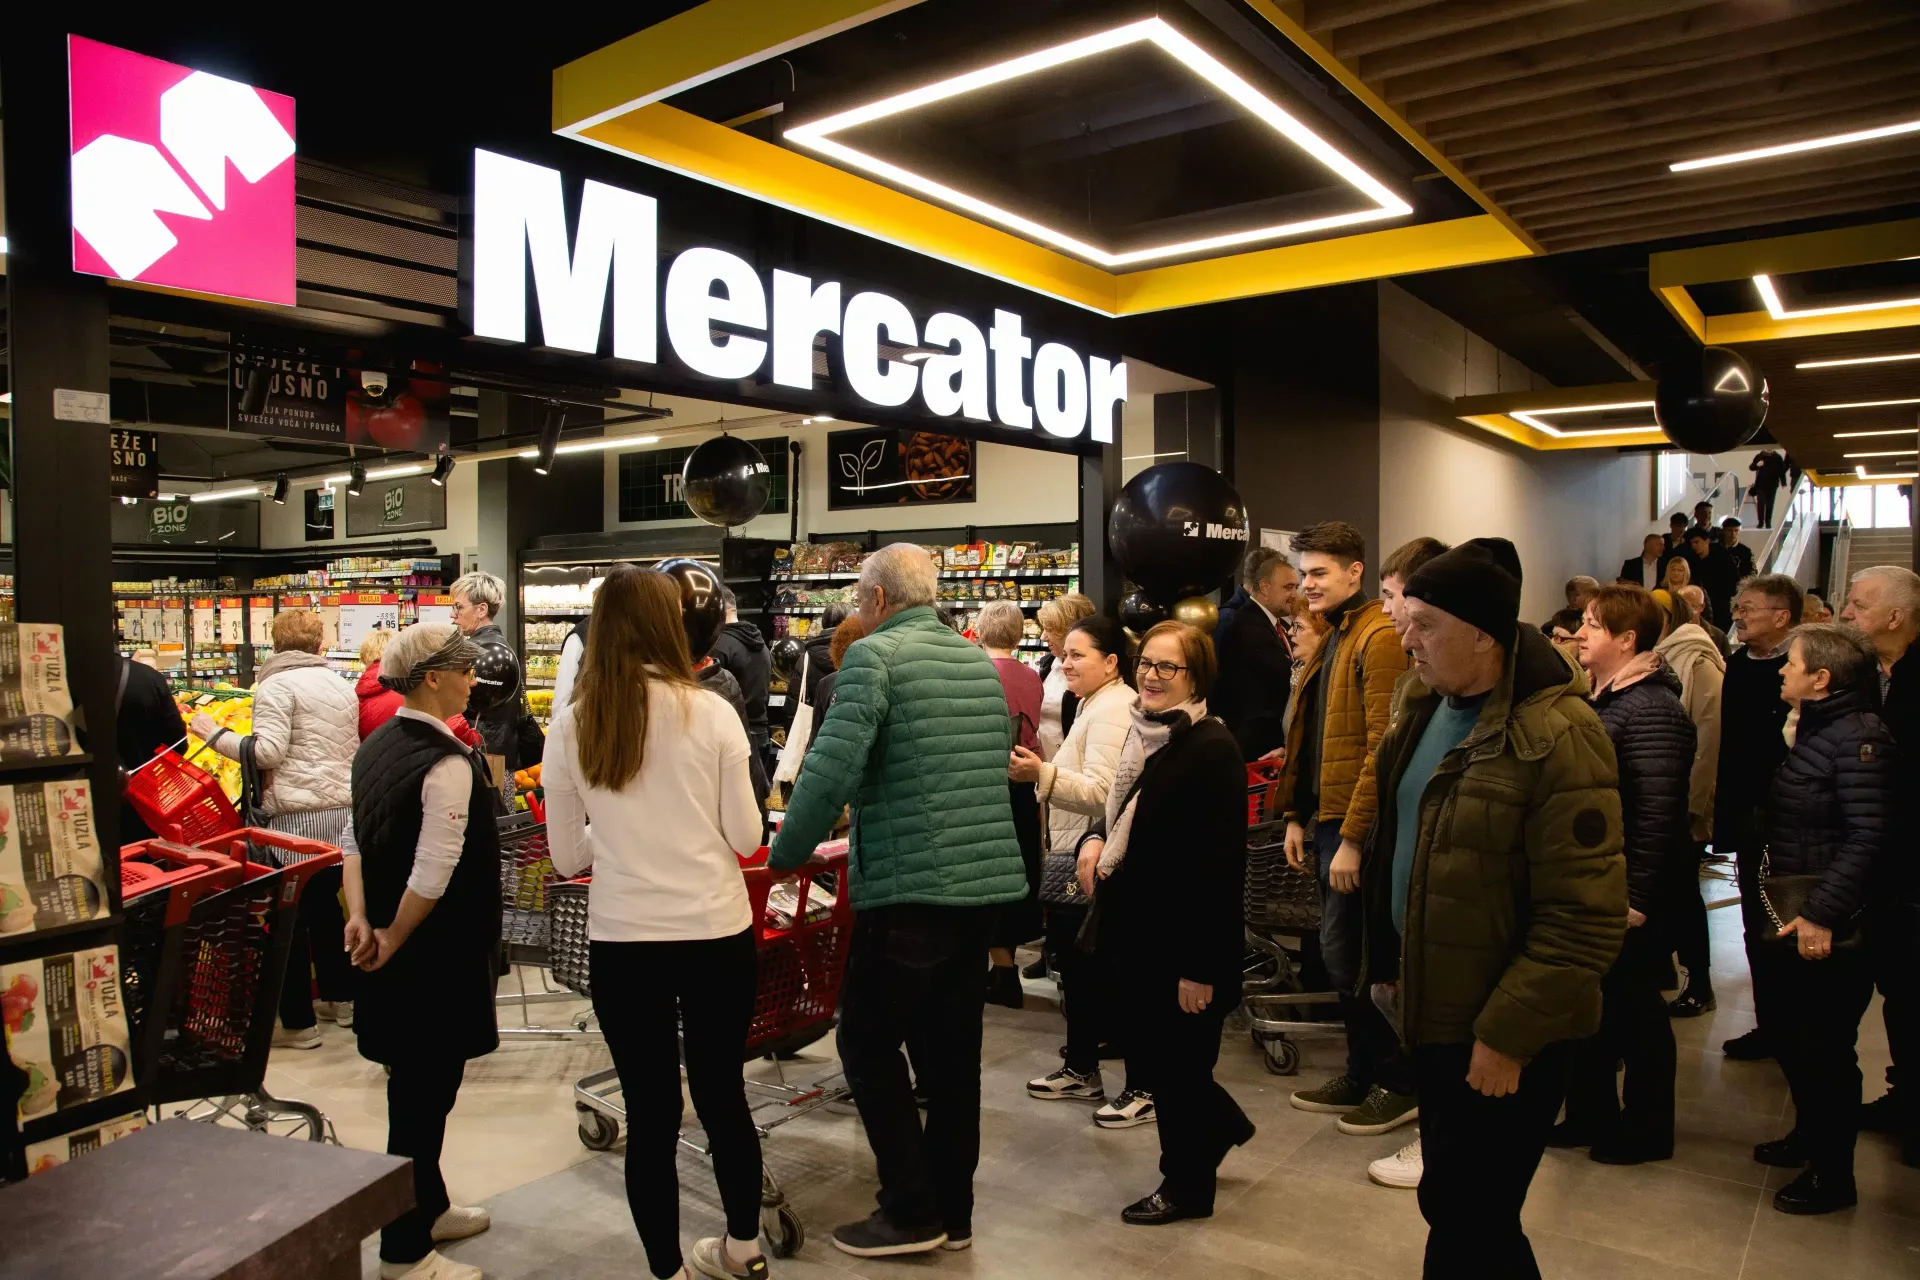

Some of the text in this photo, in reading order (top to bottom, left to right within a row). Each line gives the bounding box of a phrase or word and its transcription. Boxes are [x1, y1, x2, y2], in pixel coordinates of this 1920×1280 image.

[474, 147, 1127, 443] Mercator
[283, 408, 315, 419] PONUDA
[113, 450, 147, 467] SNO
[386, 509, 404, 520] ZONE
[157, 524, 188, 533] ZONE
[360, 595, 380, 603] AKCIJA
[385, 620, 396, 629] 95
[46, 655, 62, 693] TUZLA
[73, 811, 91, 850] TUZLA
[101, 977, 119, 1019] TUZLA
